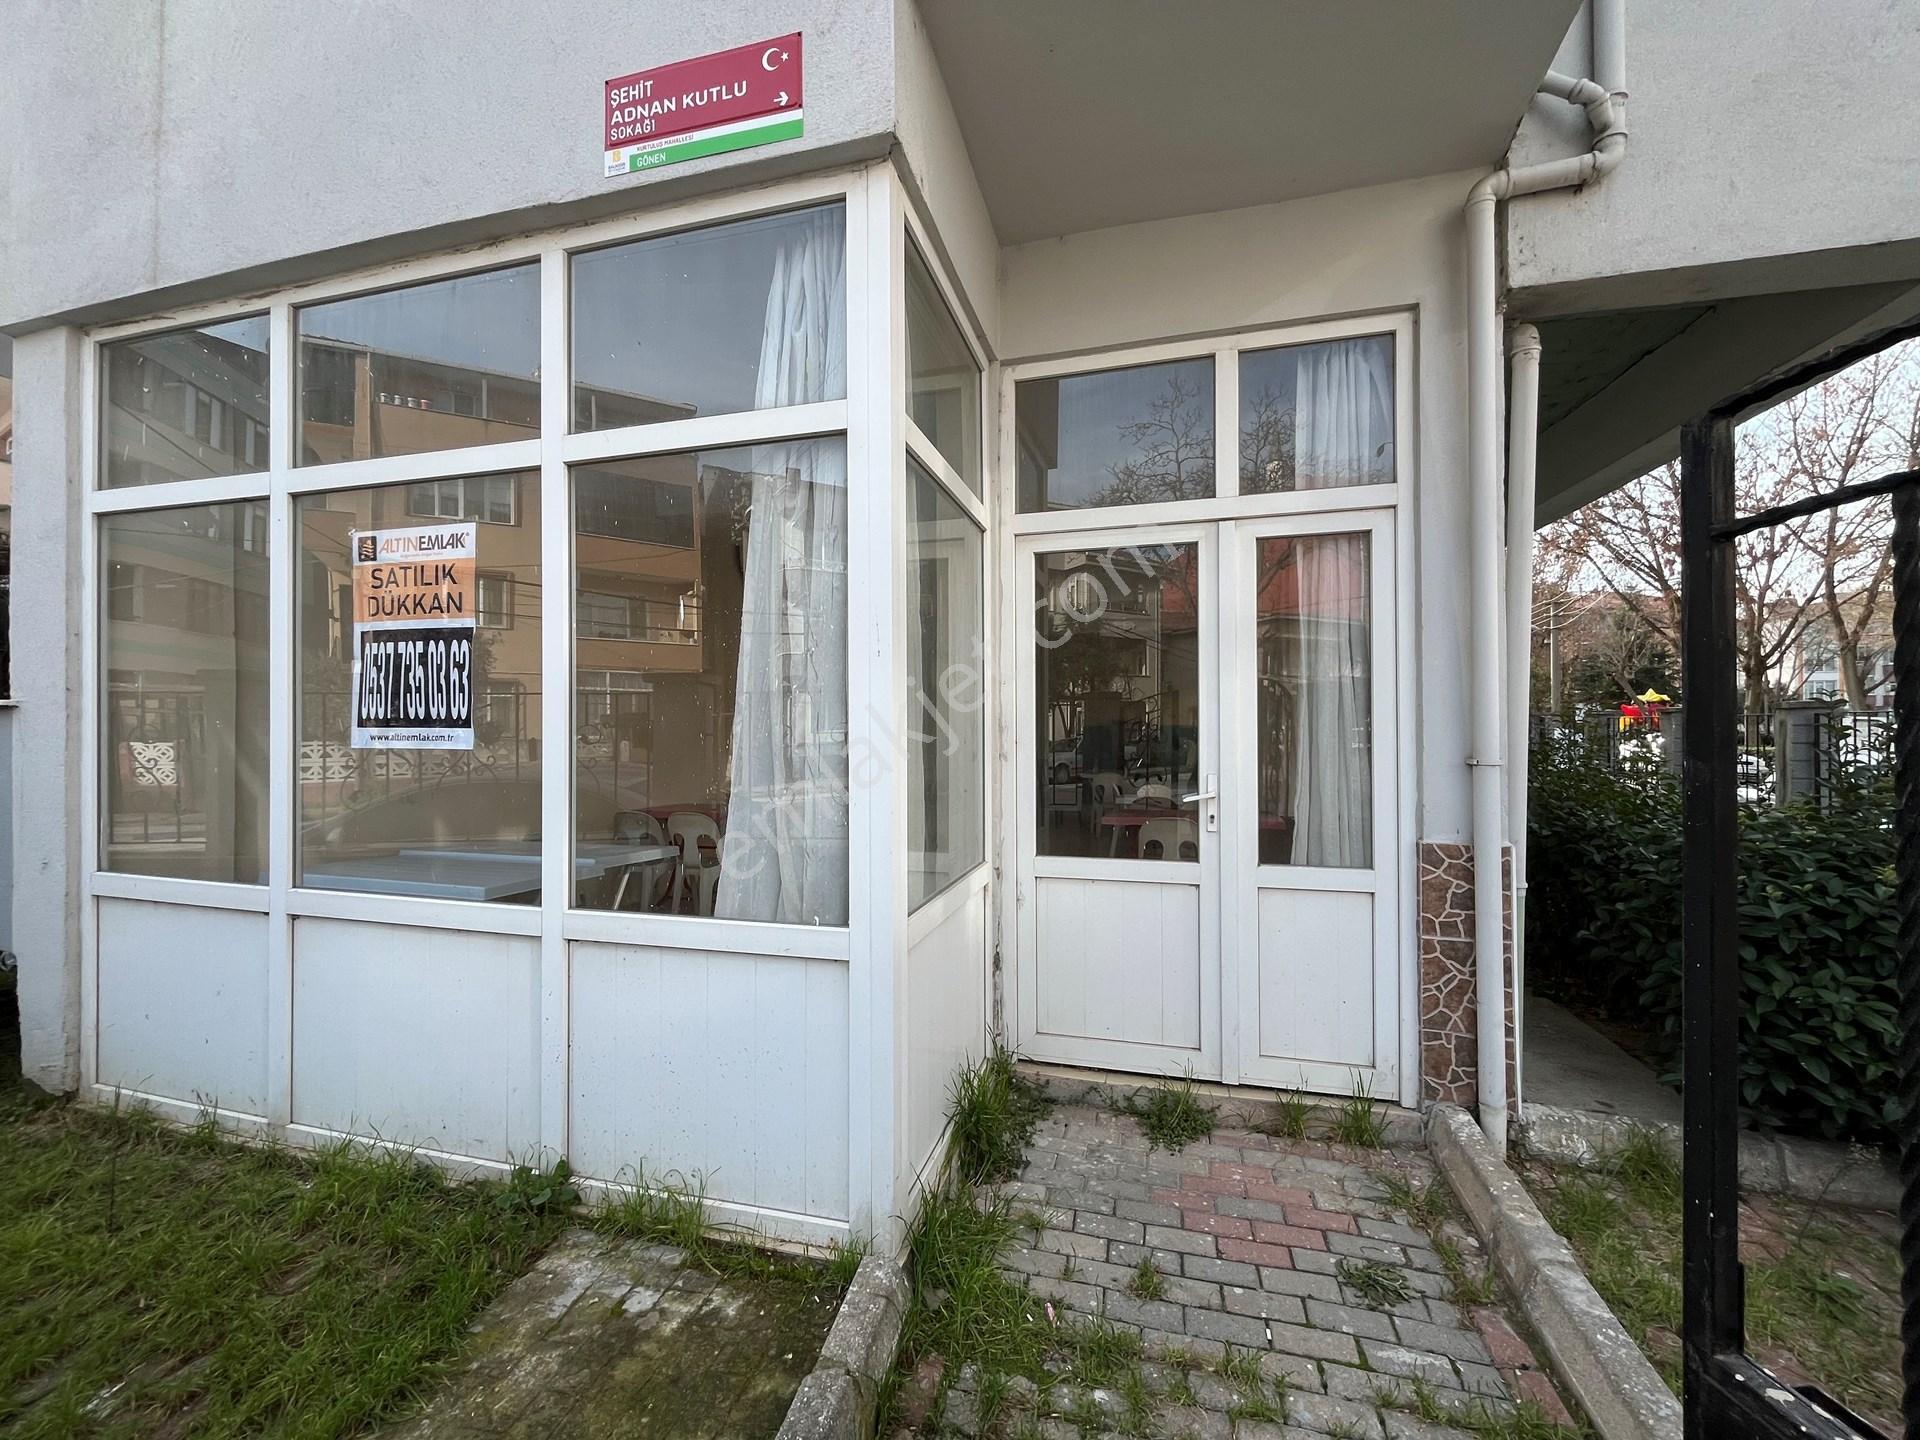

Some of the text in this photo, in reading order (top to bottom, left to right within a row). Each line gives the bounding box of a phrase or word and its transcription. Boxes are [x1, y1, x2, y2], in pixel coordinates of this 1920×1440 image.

[610, 80, 653, 108] ŞEHİT
[611, 80, 747, 125] ADNAN KUTLU
[610, 119, 655, 141] SOKAĞI
[636, 152, 666, 167] GÖNEN
[371, 562, 458, 589] SATILIK
[368, 591, 463, 617] DÜKKAN
[361, 639, 470, 720] 0537 735 03 63
[370, 733, 454, 742] www.altinemlak.com.tr
